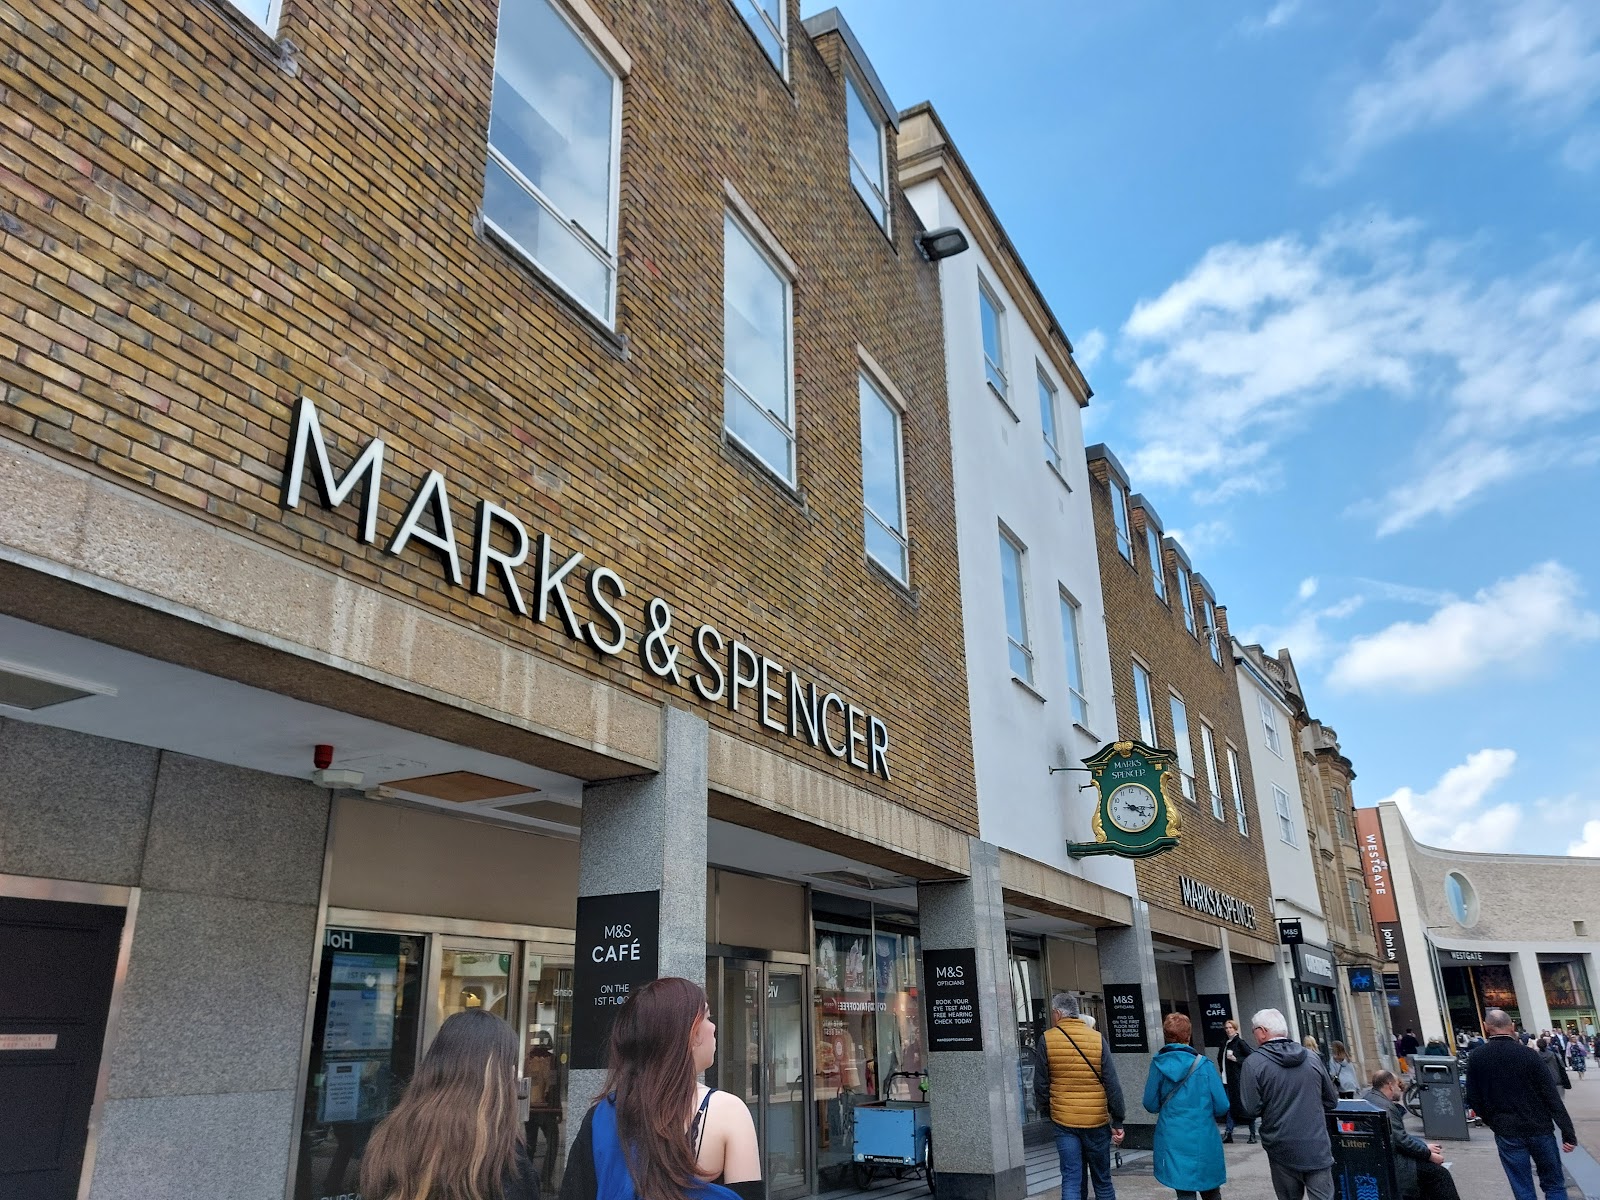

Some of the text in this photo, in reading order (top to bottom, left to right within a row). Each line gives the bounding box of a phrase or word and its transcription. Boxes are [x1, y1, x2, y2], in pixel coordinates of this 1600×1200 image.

[283, 396, 892, 781] MARKS & SPENCER
[1114, 759, 1142, 769] MARKS
[1111, 768, 1146, 780] SPENCER
[1365, 833, 1386, 895] WESTGATE
[1179, 875, 1257, 930] MARKS & SPENCER
[604, 923, 632, 940] M&S
[1380, 928, 1395, 947] John
[591, 937, 641, 963] CAFÉ
[1450, 951, 1483, 960] WESTGATE
[936, 965, 964, 979] M&S
[600, 983, 630, 994] ON THE
[594, 996, 608, 1006] 1ST
[1113, 995, 1134, 1004] M&S
[1206, 1007, 1226, 1016] CAFÉ
[1340, 1138, 1367, 1148] Litter
